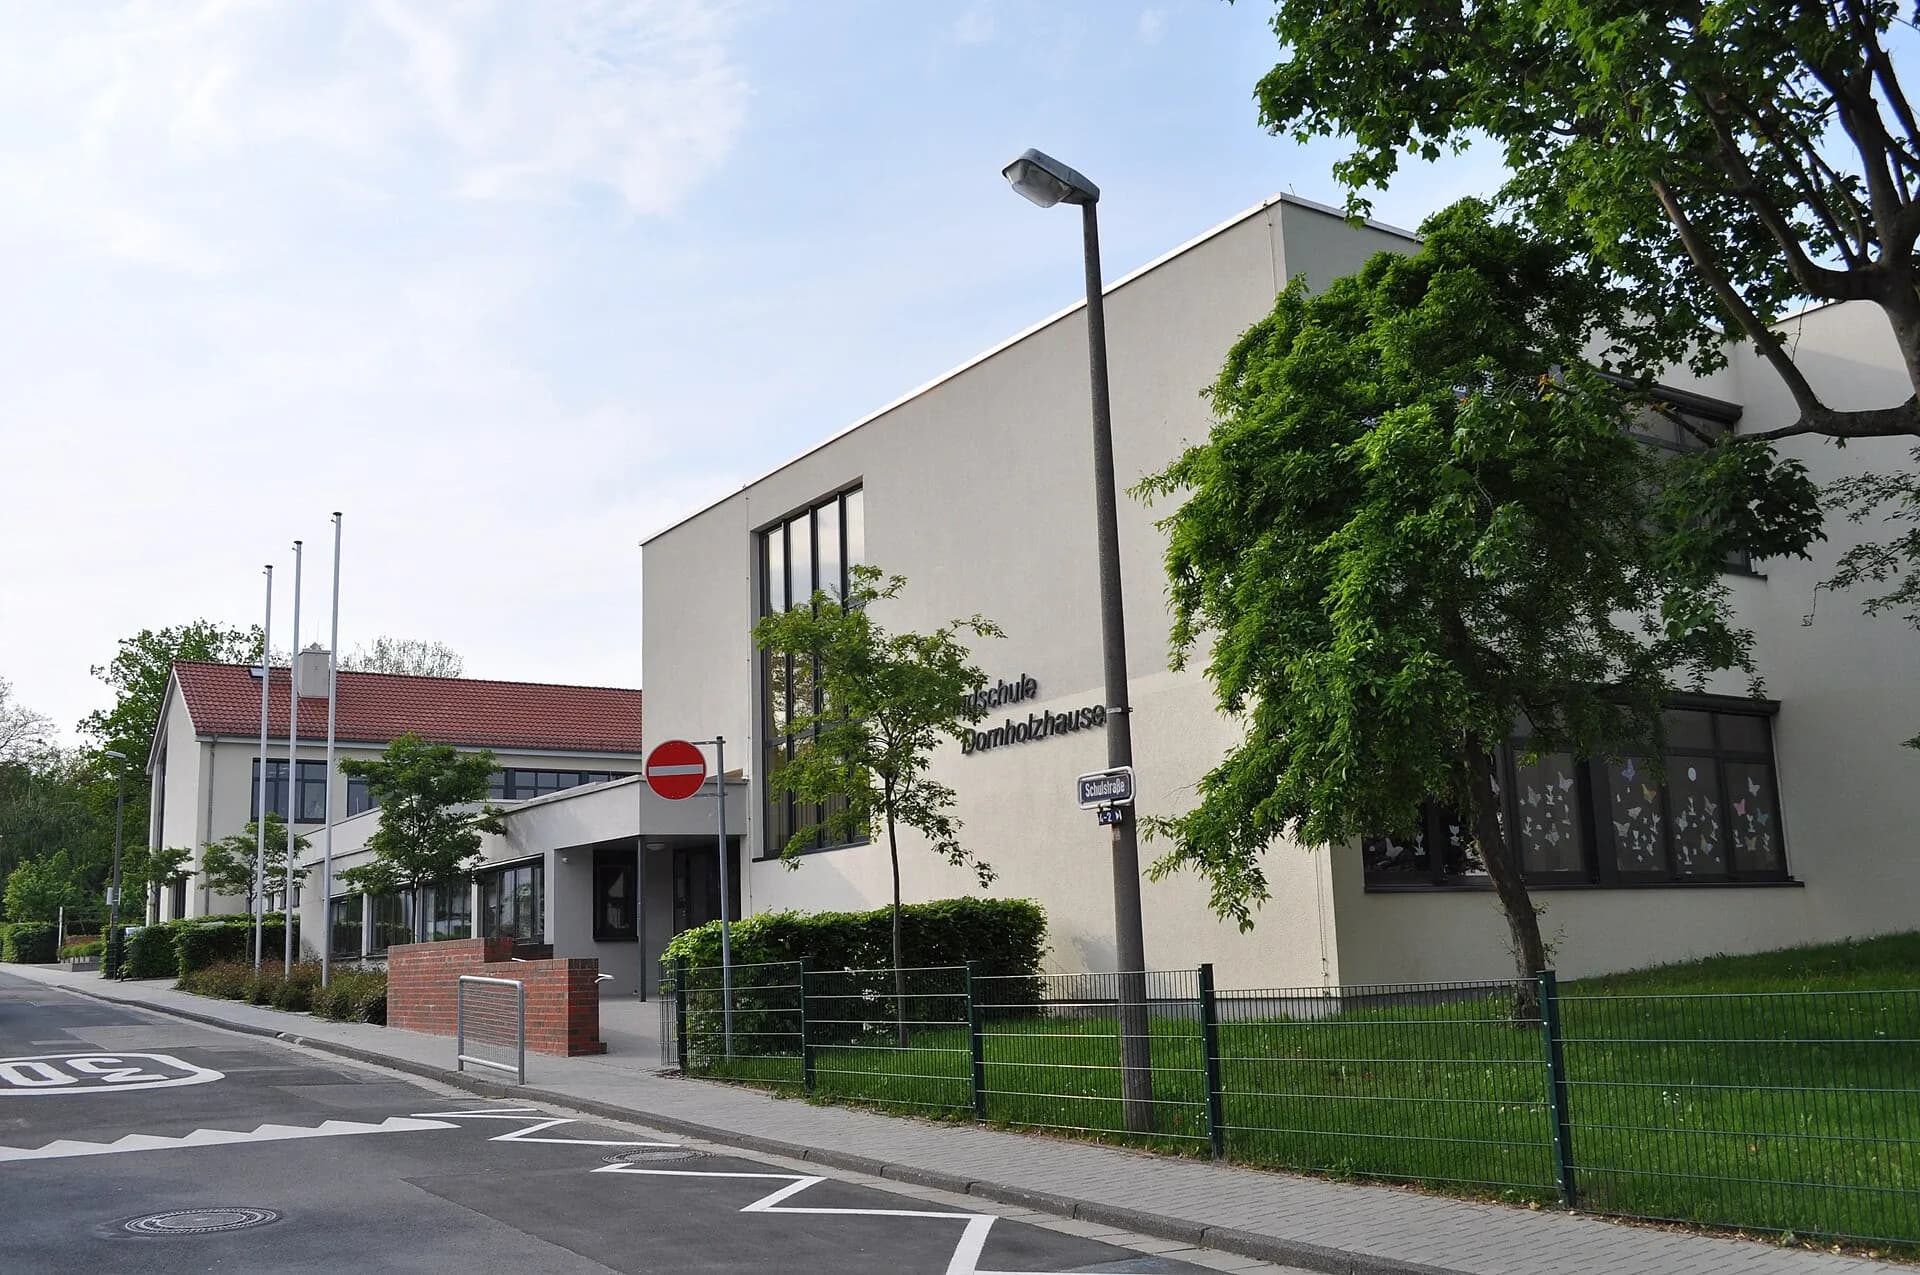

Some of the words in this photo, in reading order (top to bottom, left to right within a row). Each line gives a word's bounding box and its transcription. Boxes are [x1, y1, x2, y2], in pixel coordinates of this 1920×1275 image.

[961, 704, 1106, 754] Dornholzhause
[1085, 778, 1125, 798] Schulstraße
[0, 1057, 169, 1086] 30
